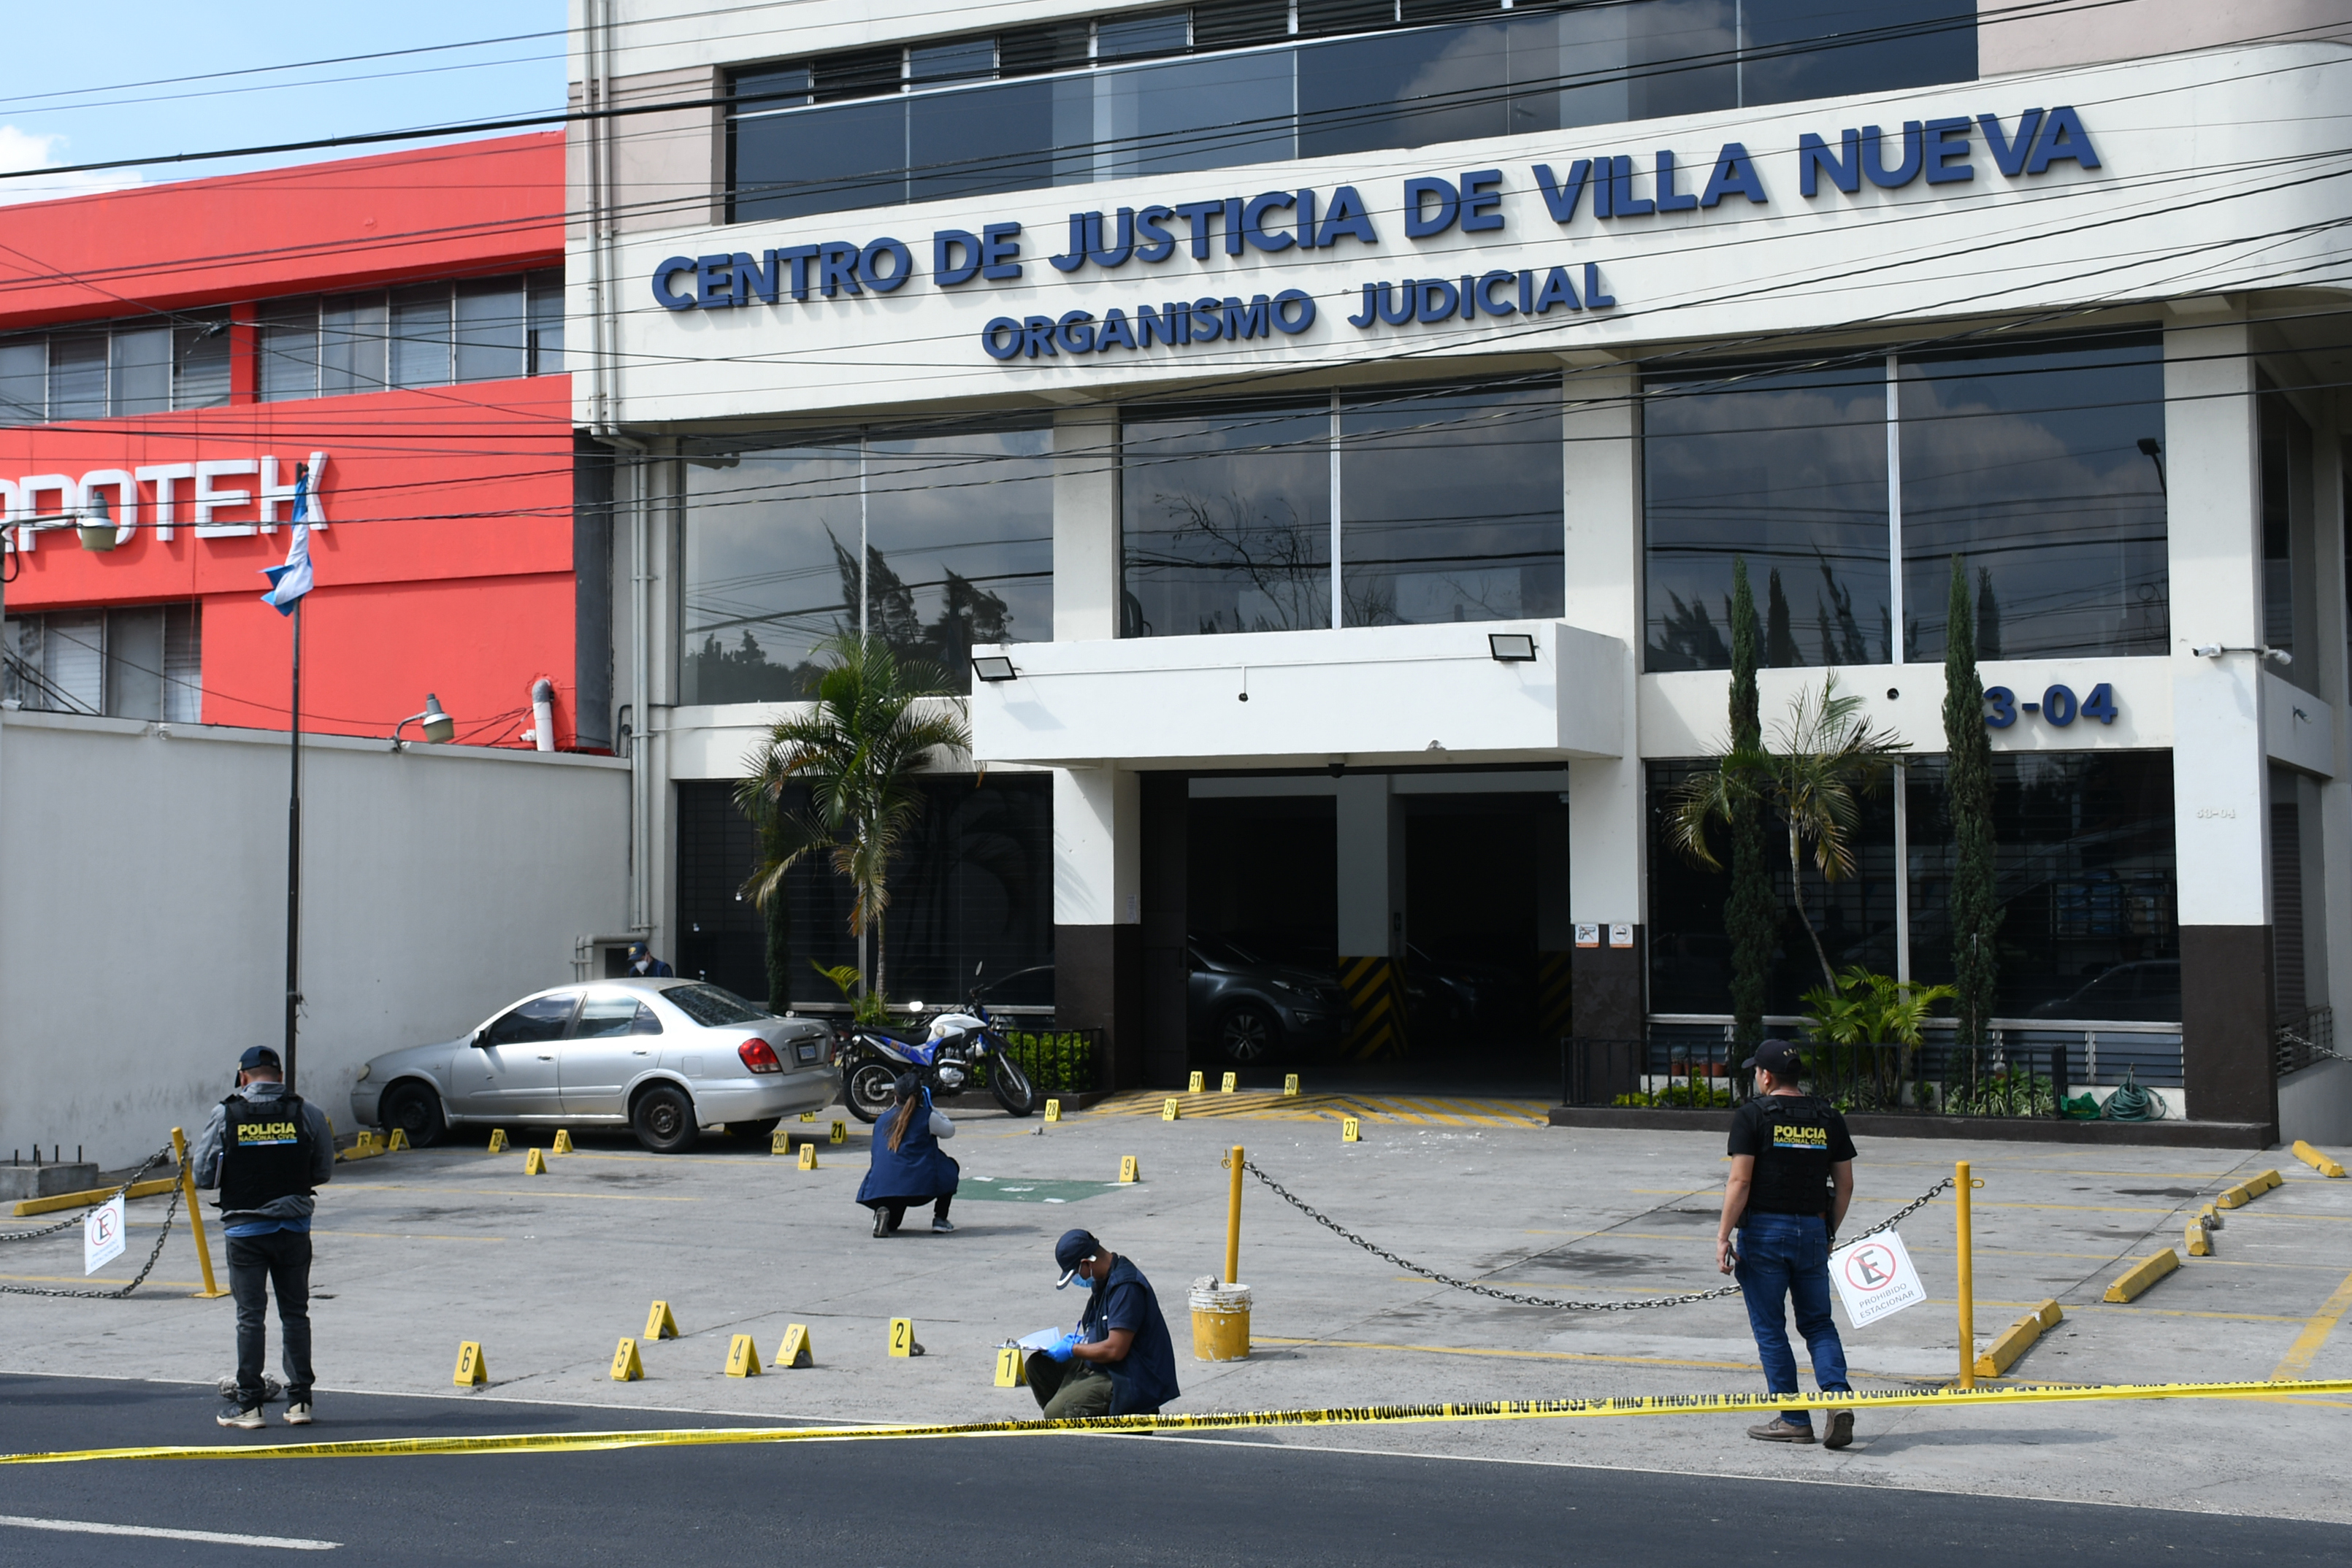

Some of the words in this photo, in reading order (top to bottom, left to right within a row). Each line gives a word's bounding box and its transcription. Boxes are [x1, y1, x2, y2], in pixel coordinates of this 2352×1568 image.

[651, 237, 913, 311] CENTRO
[933, 221, 1022, 288] DE
[1048, 185, 1379, 273] JUSTICIA
[1403, 169, 1505, 240] DE
[1531, 142, 1769, 225] VILLA
[1799, 105, 2102, 198] NUEVA
[981, 288, 1316, 361] ORGANISMO
[1347, 262, 1616, 330] JUDICIAL
[1191, 1074, 1200, 1088] 31
[1223, 1074, 1233, 1088] 32
[1286, 1077, 1295, 1091] 30
[1047, 1102, 1056, 1116] 28
[1165, 1102, 1174, 1115] 29
[237, 1122, 296, 1136] POLICIA
[831, 1123, 842, 1139] 21
[1345, 1121, 1355, 1137] 27
[1773, 1125, 1827, 1140] POLICIA
[773, 1132, 785, 1148] 20
[529, 1151, 535, 1167] 8
[802, 1147, 811, 1163] 10
[1124, 1158, 1131, 1176] 9
[1858, 1283, 1907, 1308] PROHIBIDO
[1859, 1290, 1915, 1318] ESTACIONAR
[651, 1304, 661, 1329] 7
[785, 1328, 799, 1353] 3
[895, 1322, 905, 1349] 2
[461, 1345, 472, 1373] 6
[617, 1342, 628, 1368] 5
[732, 1339, 743, 1365] 4
[1005, 1350, 1014, 1378] 1
